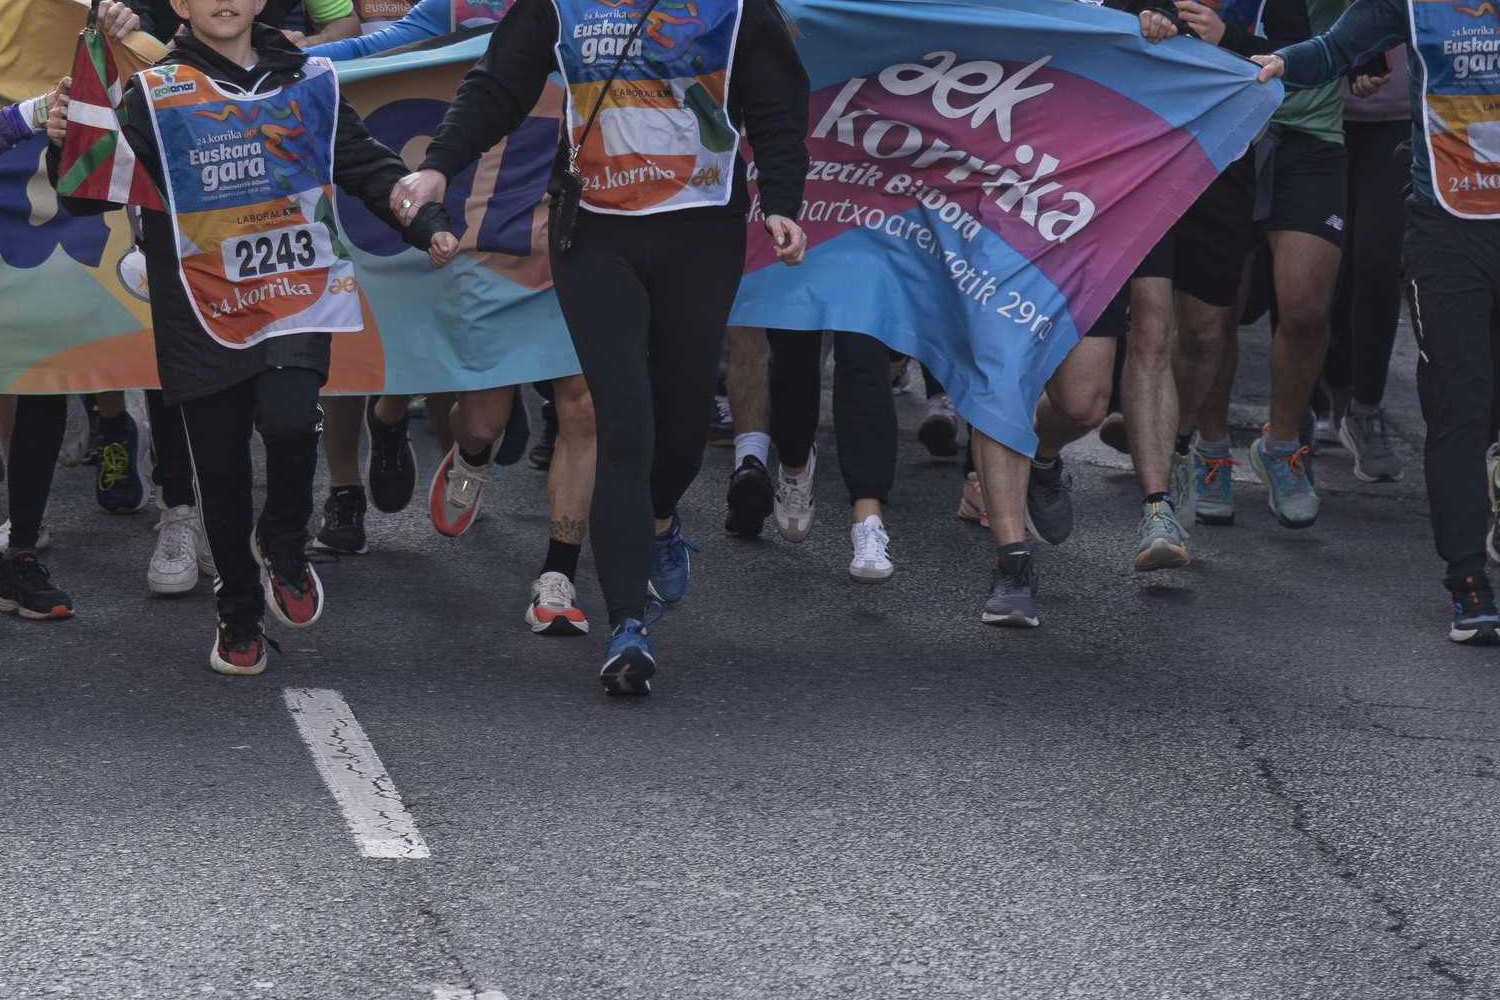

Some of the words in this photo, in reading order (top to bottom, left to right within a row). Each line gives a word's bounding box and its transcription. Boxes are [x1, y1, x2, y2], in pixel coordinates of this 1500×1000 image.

[583, 9, 626, 21] 24.korrika
[1452, 26, 1494, 37] 24.korrika
[613, 88, 656, 98] LABORAL
[878, 51, 1055, 143] aek
[197, 130, 242, 146] 24.korrika
[189, 141, 262, 167] Euskara
[811, 77, 1096, 244] korrika
[201, 157, 266, 192] gara
[691, 160, 722, 187] aek
[237, 210, 282, 225] LABORAL
[884, 173, 983, 242] Bilbora
[235, 229, 316, 278] 2243
[208, 277, 314, 319] 24.korrika
